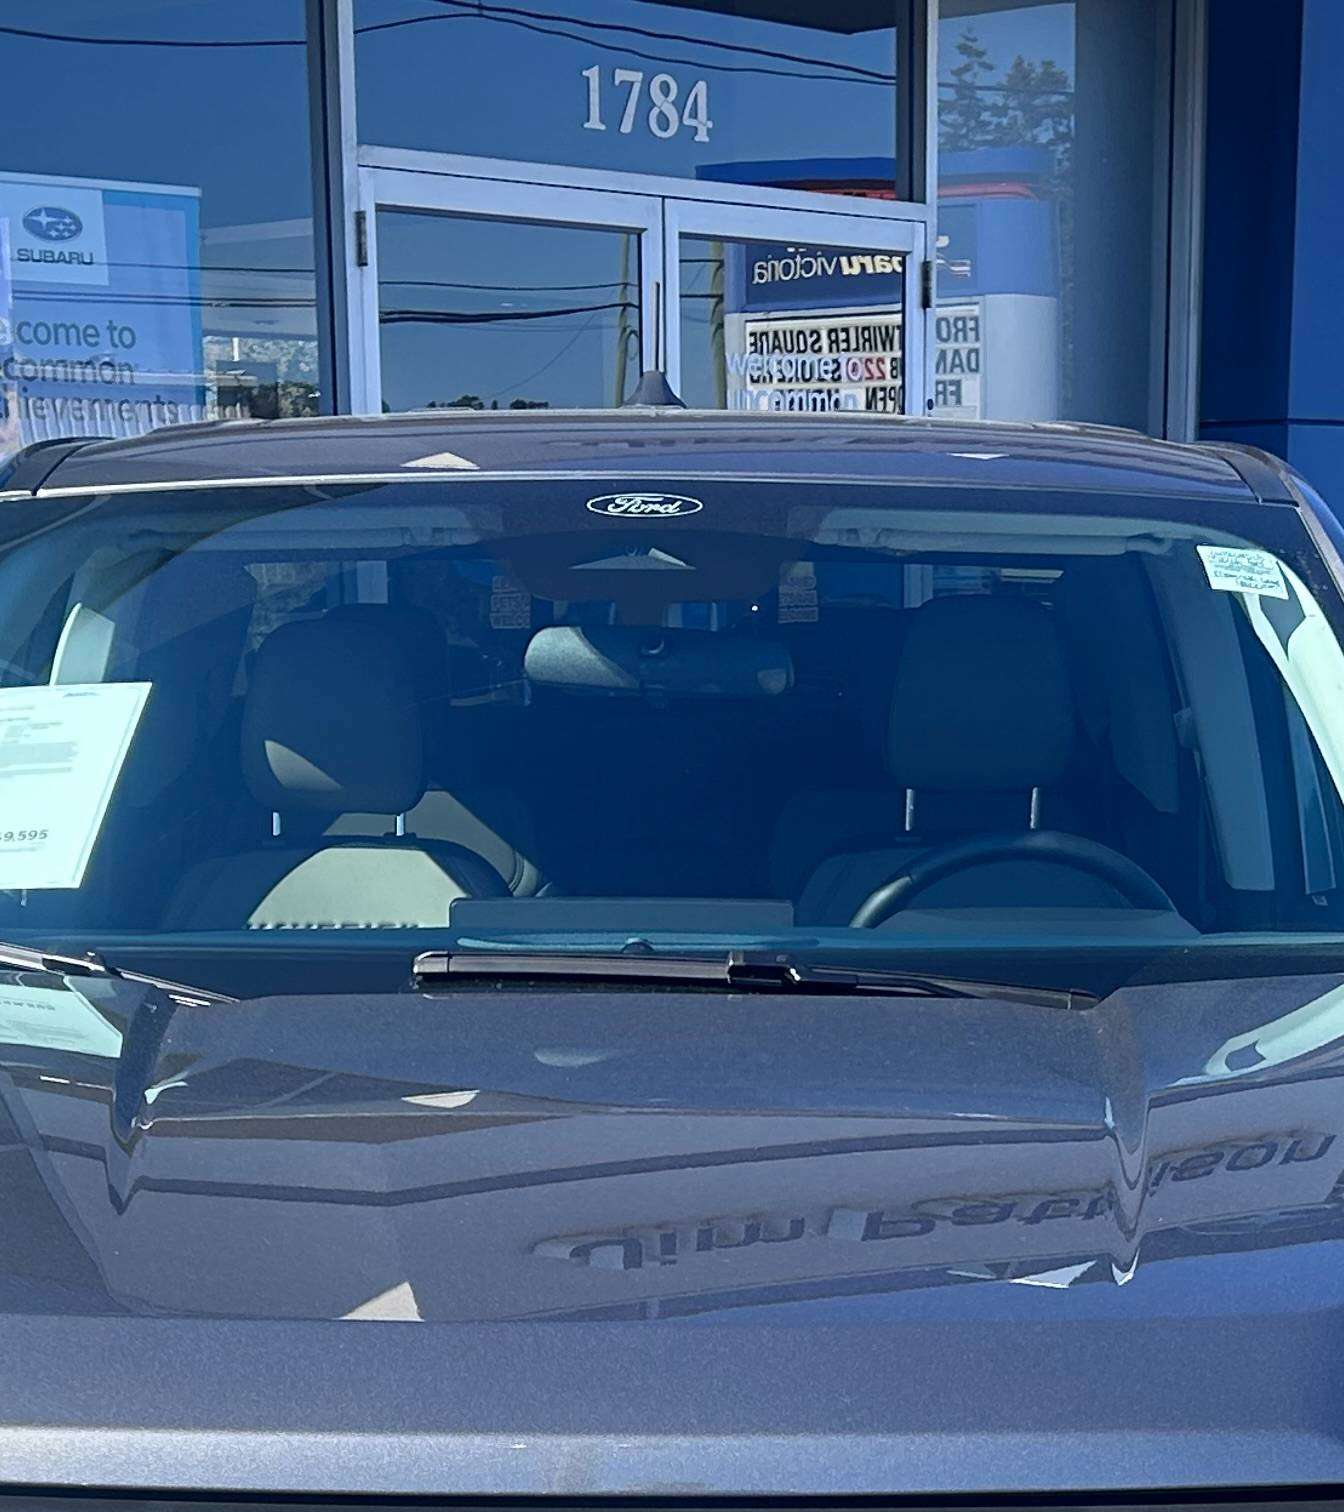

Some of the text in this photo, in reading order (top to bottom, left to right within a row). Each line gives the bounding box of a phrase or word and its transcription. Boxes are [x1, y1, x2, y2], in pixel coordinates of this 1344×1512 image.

[582, 65, 714, 142] 1784
[16, 248, 94, 266] SUBARU
[106, 319, 136, 349] to
[607, 496, 683, 514] Ford
